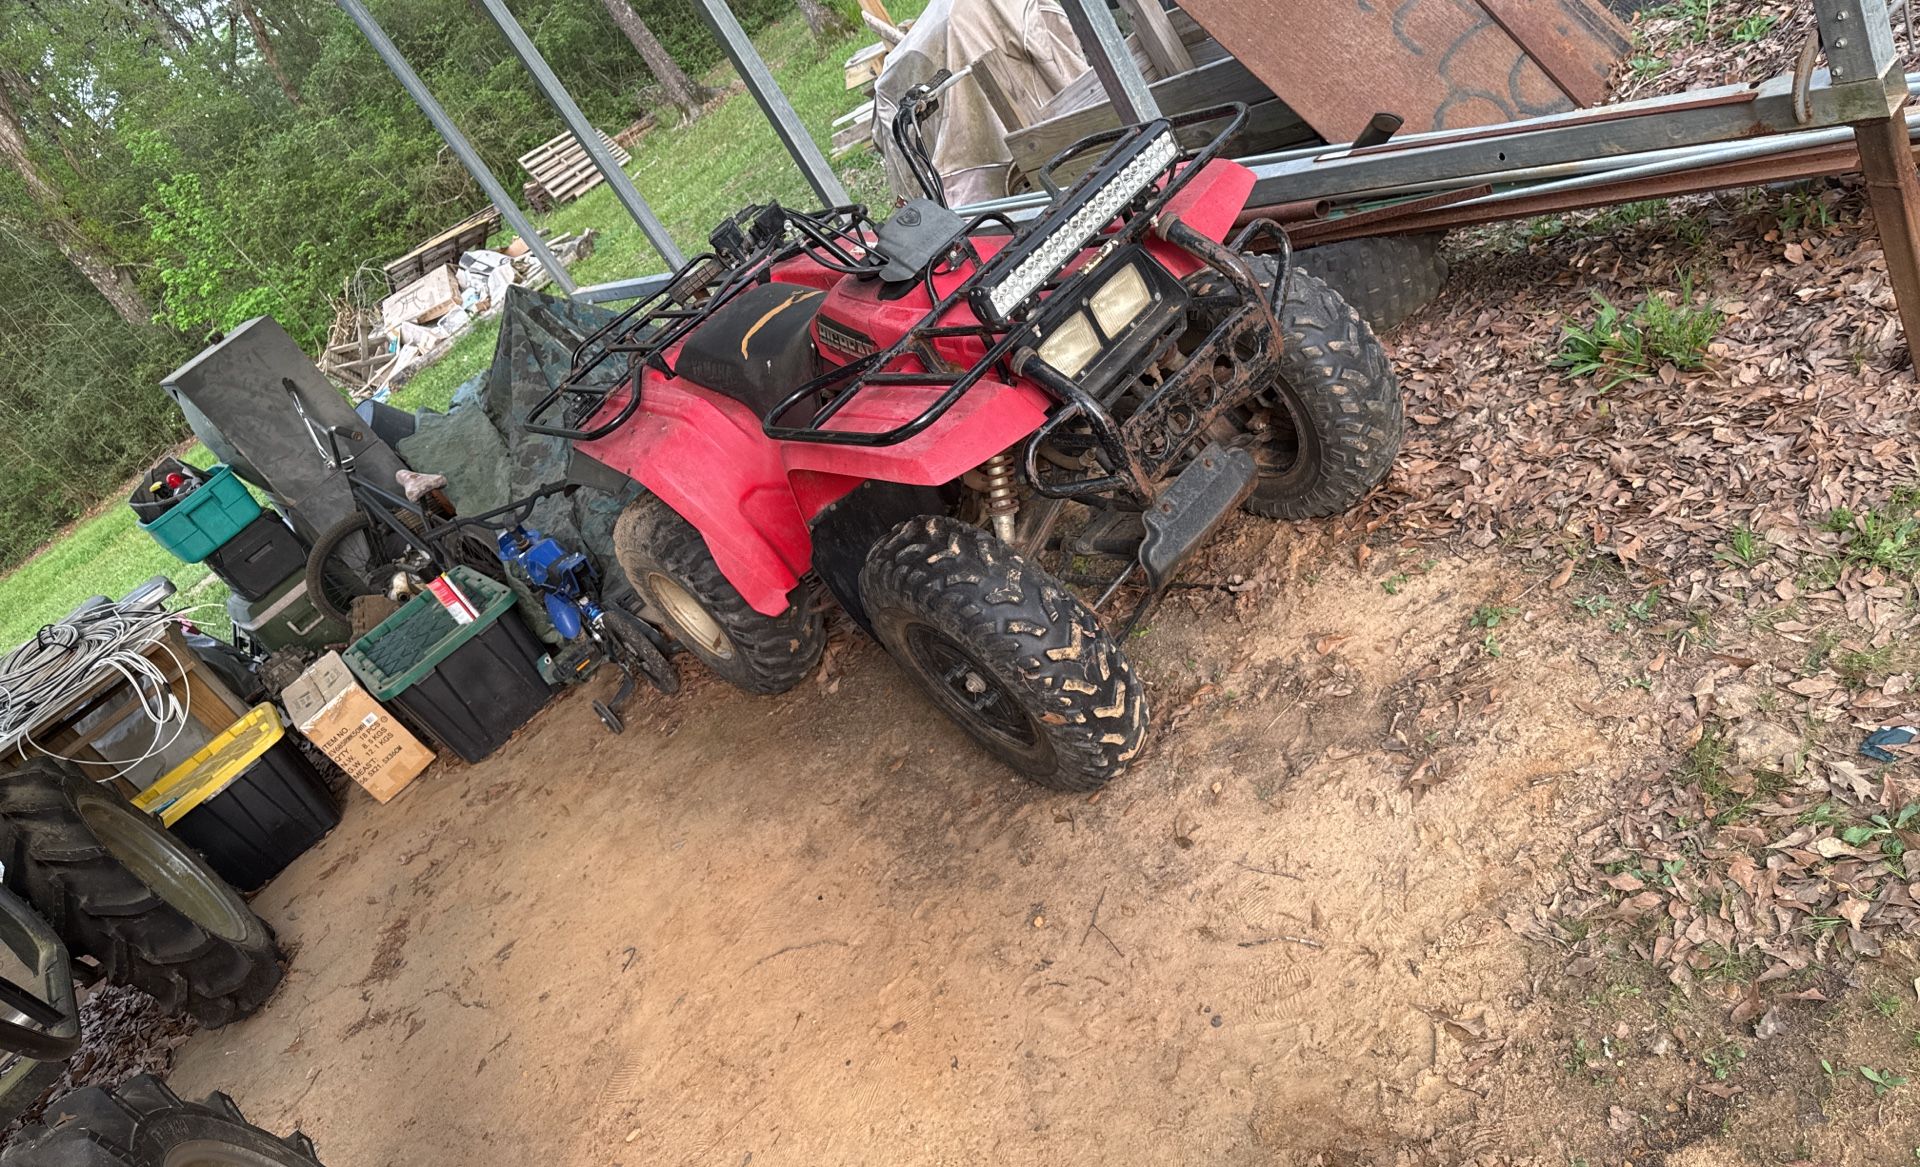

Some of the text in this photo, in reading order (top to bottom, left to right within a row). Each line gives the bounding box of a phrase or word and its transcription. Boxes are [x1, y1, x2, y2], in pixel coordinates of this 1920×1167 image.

[321, 727, 351, 752] ITEM NO.
[359, 732, 369, 742] 18
[366, 722, 381, 734] PCS
[373, 727, 388, 741] KGS
[379, 732, 394, 746] KGS
